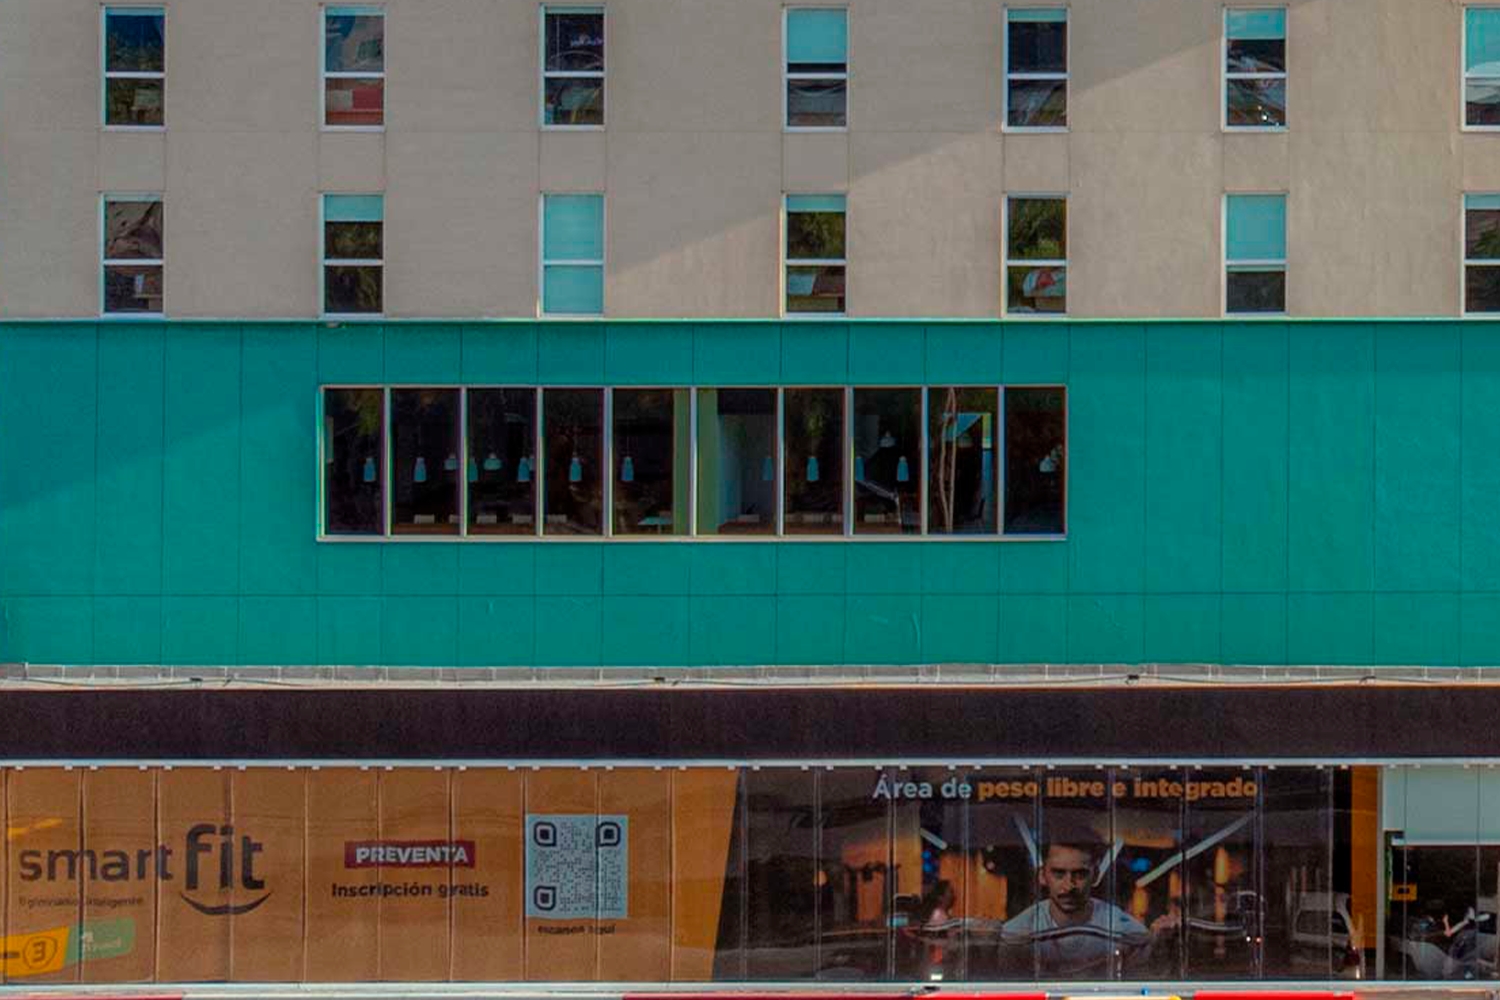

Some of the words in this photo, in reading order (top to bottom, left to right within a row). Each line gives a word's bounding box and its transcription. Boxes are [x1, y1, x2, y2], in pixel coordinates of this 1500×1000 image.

[873, 774, 932, 799] Área
[941, 778, 972, 798] de
[978, 782, 1039, 801] peso
[1047, 777, 1105, 798] libre
[1112, 782, 1127, 798] e
[1133, 777, 1258, 801] integrado
[19, 844, 173, 882] smart
[185, 823, 265, 890] fit
[355, 847, 469, 863] PREVENTA
[332, 882, 432, 897] Inscripción
[438, 883, 489, 898] gratis
